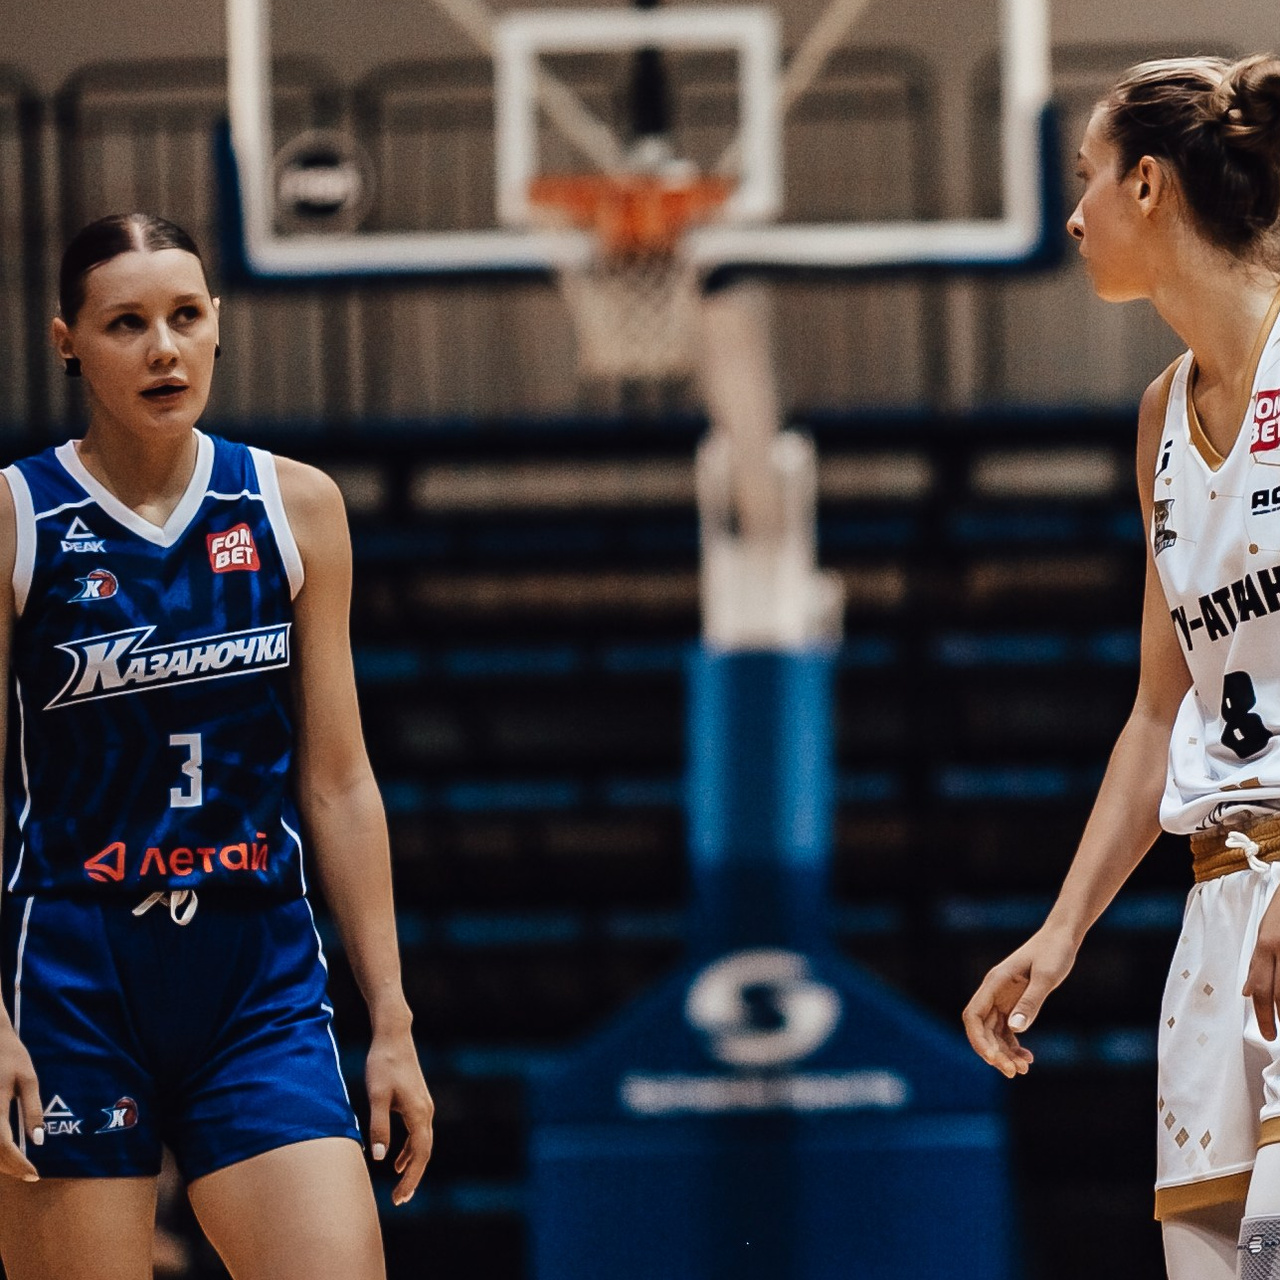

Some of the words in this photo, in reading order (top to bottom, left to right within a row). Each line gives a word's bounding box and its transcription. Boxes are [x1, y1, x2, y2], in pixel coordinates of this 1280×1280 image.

[60, 539, 107, 553] PEAK
[211, 528, 251, 554] FON
[215, 546, 254, 569] BET
[1221, 670, 1274, 759] 8
[169, 732, 203, 808] 3
[139, 832, 269, 876] летай
